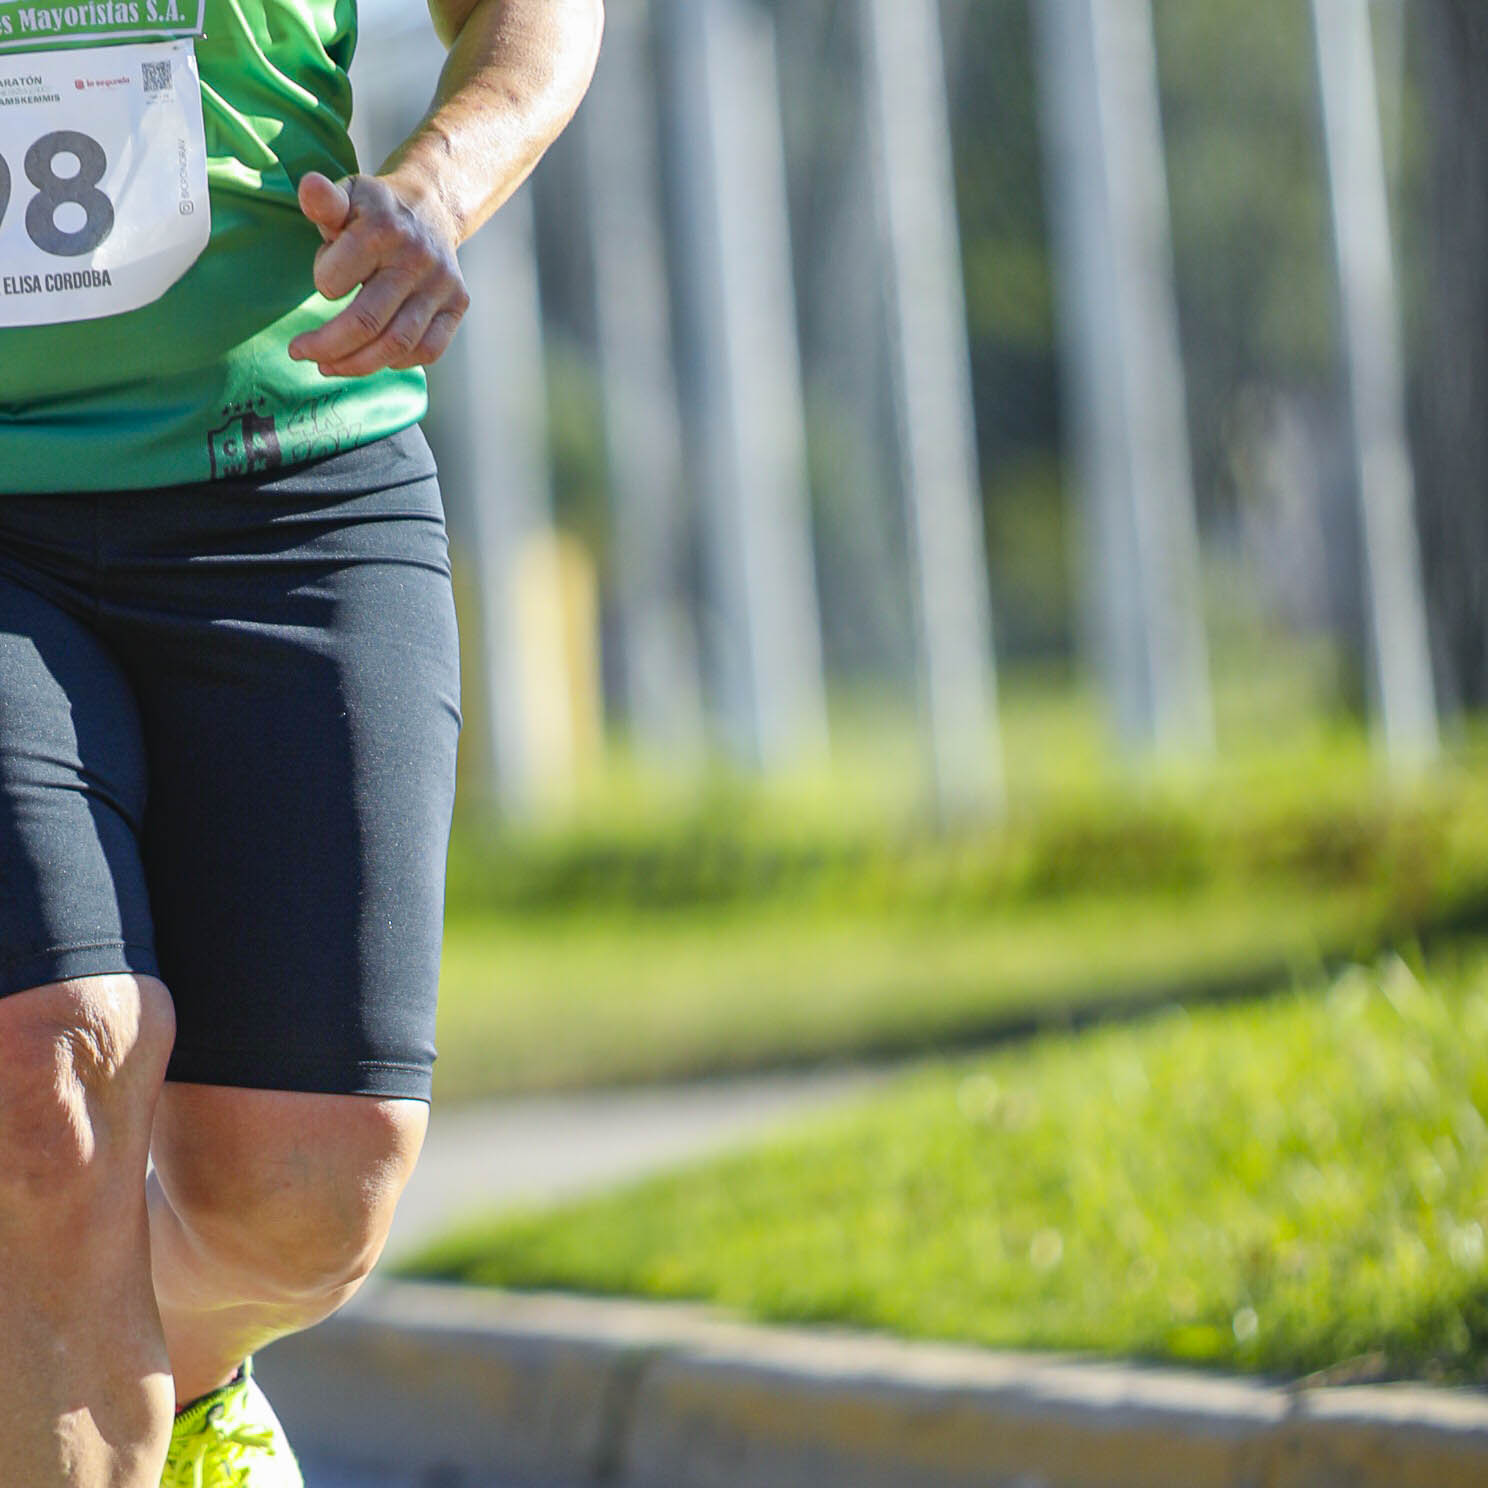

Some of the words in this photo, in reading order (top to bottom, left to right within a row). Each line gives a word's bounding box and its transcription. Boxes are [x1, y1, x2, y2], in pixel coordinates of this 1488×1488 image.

[18, 0, 139, 34] Mayoristas
[3, 275, 42, 295] ELISA
[44, 269, 112, 292] CORDOBA
